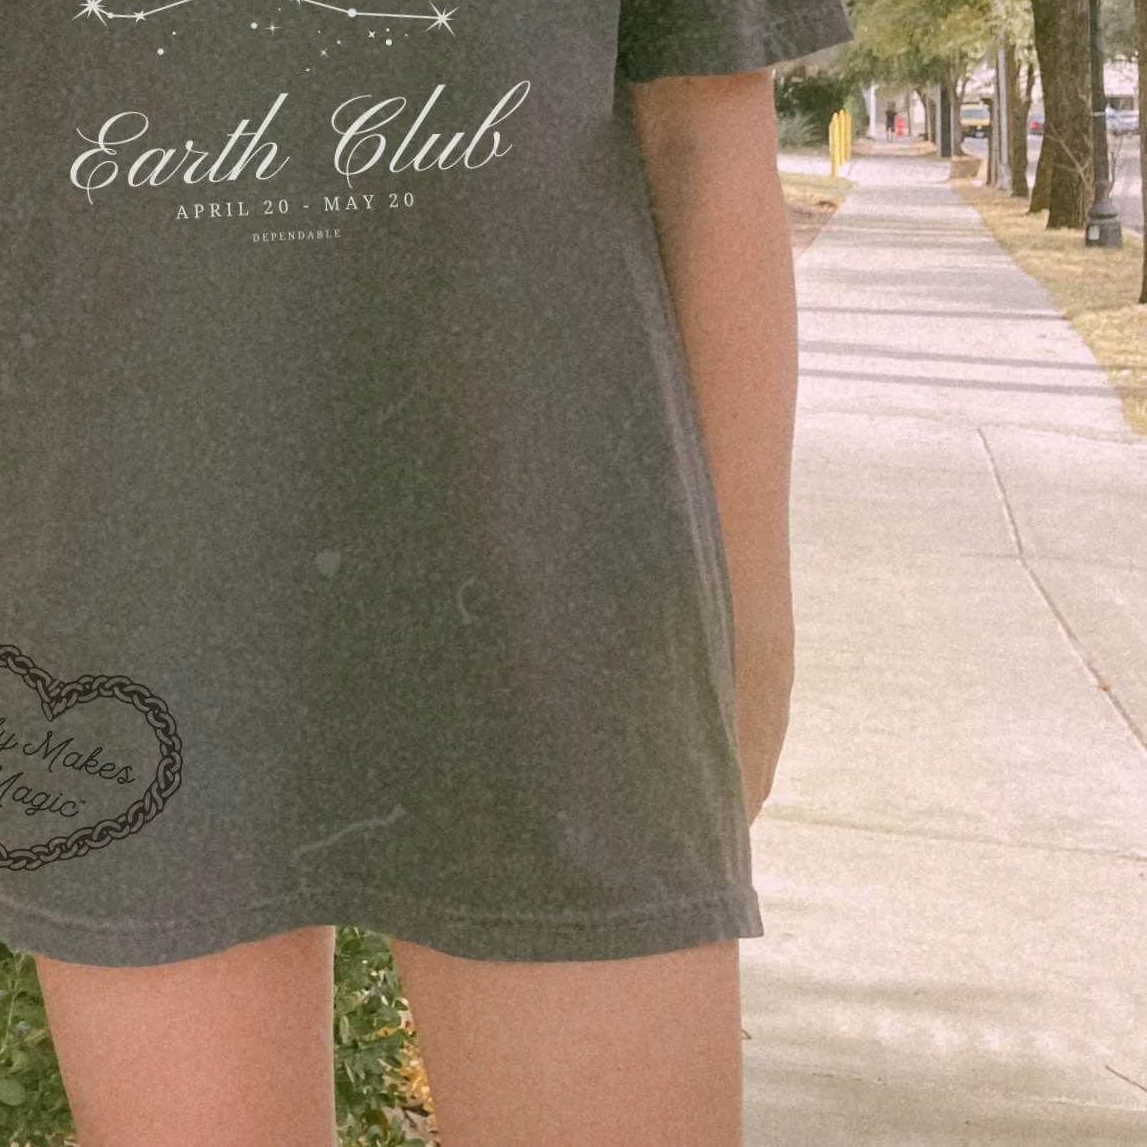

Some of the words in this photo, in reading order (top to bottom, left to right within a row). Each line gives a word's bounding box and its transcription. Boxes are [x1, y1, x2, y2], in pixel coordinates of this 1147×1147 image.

[69, 92, 291, 205] Earth
[330, 80, 532, 189] Club
[175, 201, 250, 220] APRIL
[262, 199, 289, 215] 20
[323, 194, 375, 212] MAY
[388, 192, 415, 209] 20
[251, 228, 342, 243] DEPENDABLE
